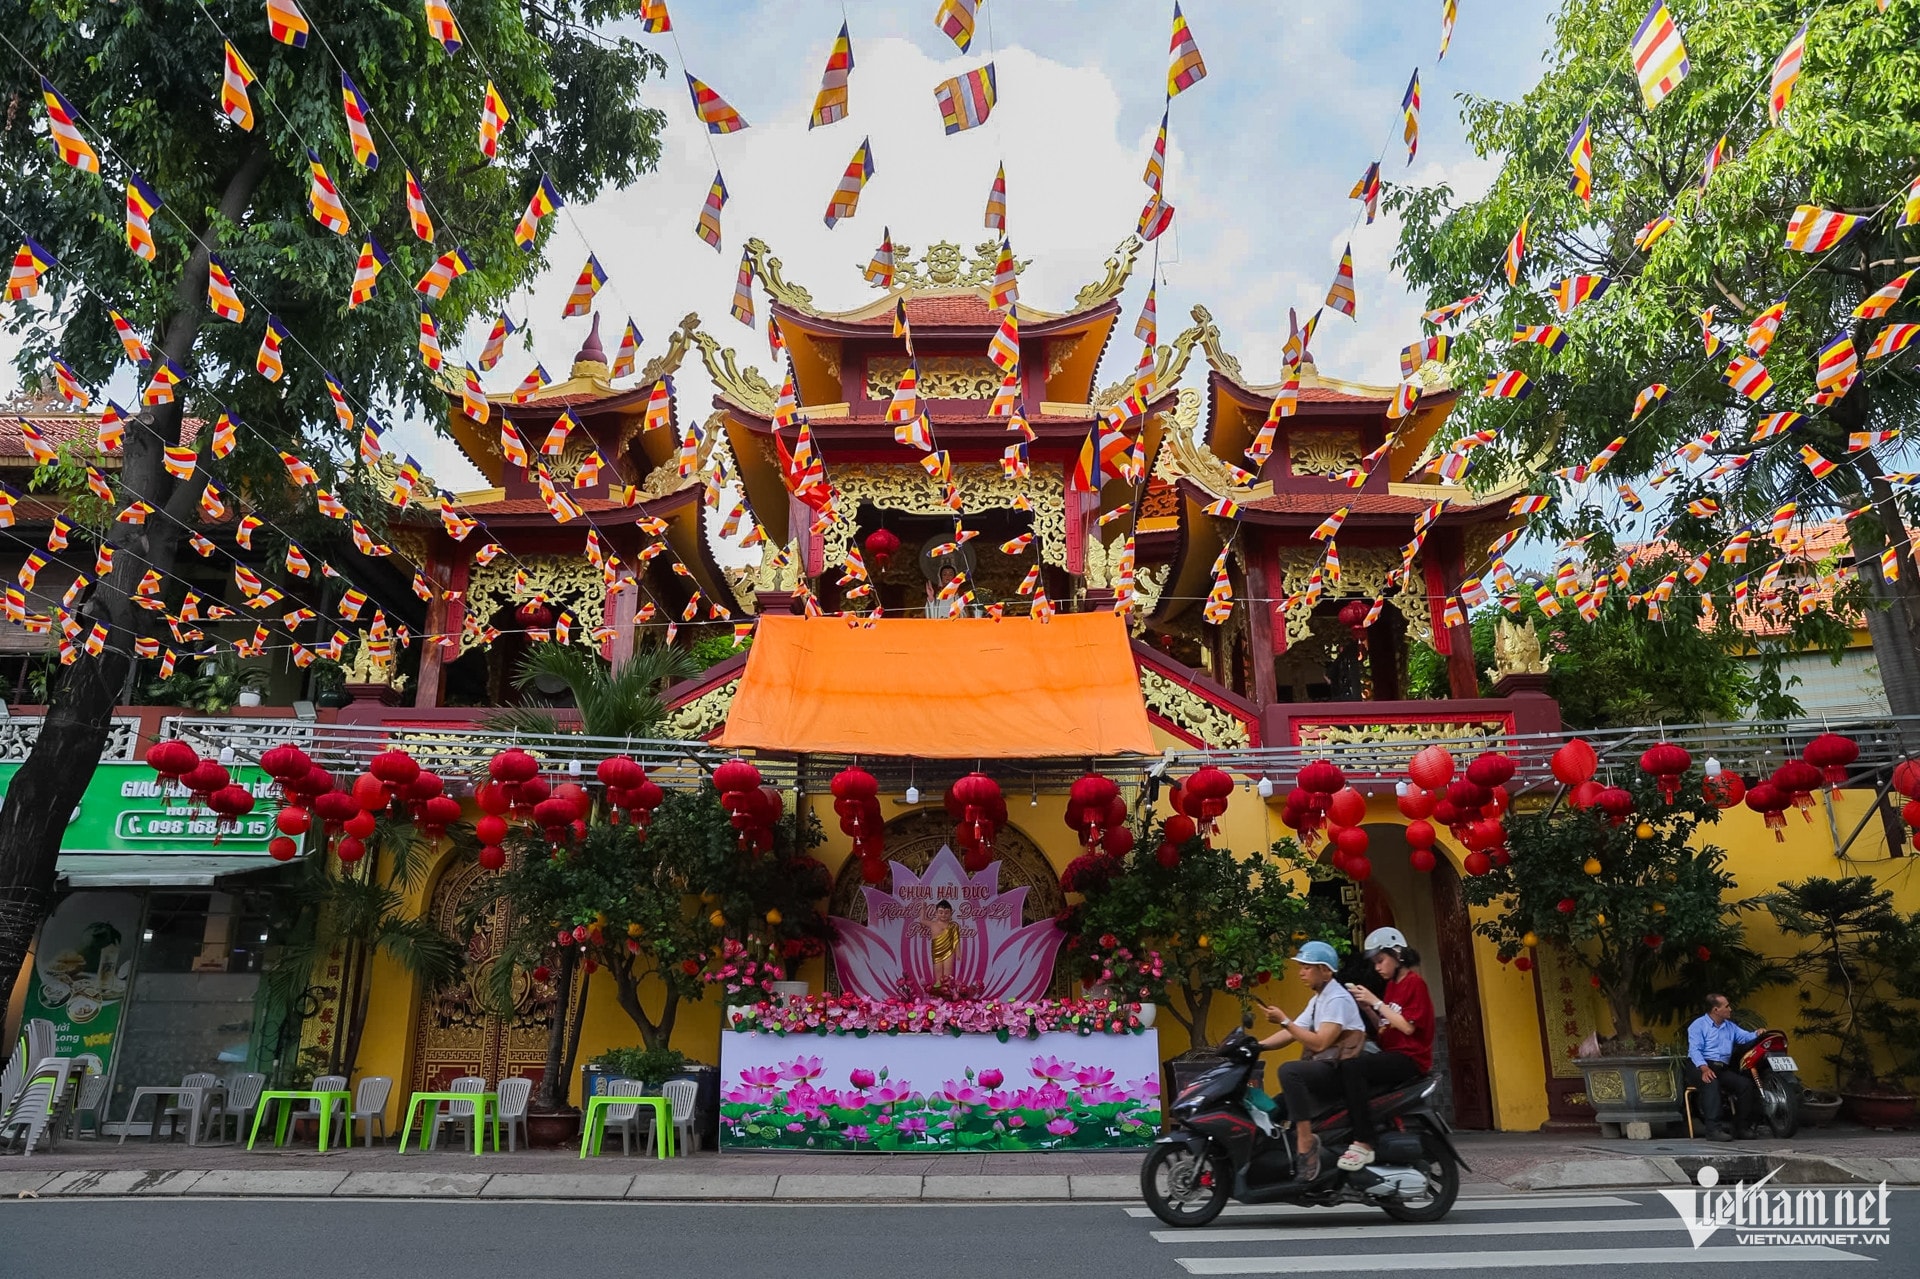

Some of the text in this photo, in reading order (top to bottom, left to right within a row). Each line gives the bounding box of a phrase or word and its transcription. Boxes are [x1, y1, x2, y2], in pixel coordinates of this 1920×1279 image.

[121, 781, 161, 798] GIAO
[148, 820, 184, 835] 098
[187, 820, 217, 835] 168
[247, 820, 267, 835] 15
[55, 1033, 80, 1044] Long
